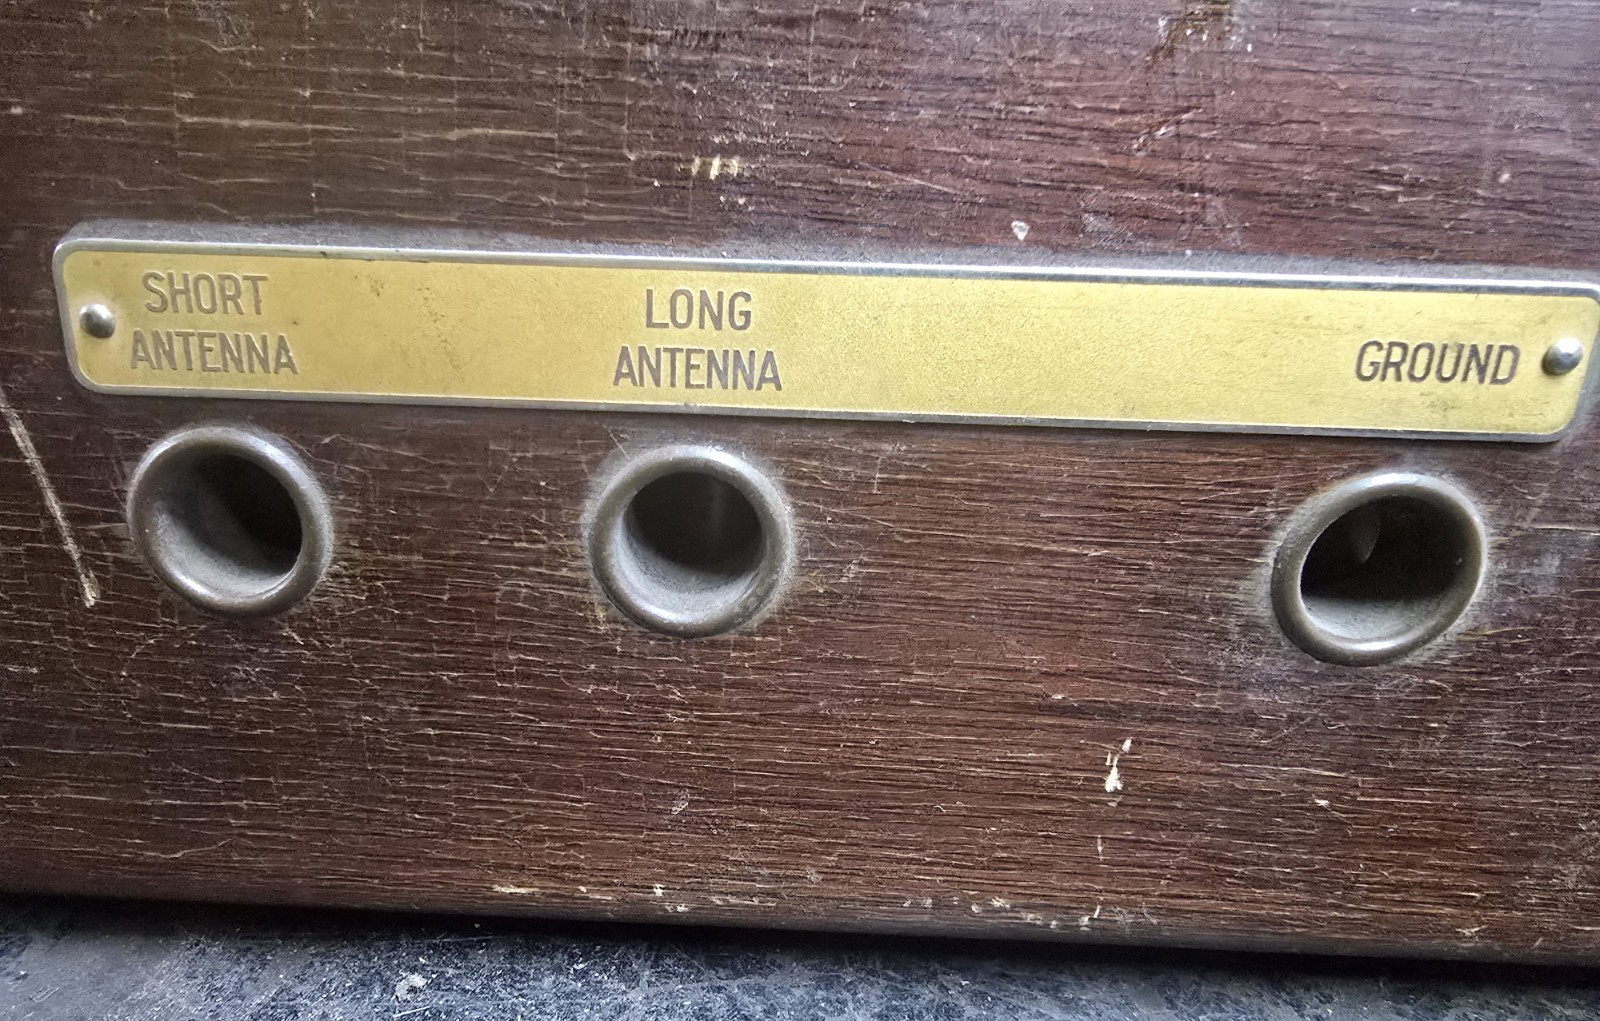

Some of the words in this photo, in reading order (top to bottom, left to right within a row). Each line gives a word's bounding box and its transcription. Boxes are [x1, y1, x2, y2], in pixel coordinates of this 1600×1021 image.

[142, 271, 269, 316] SHORT
[645, 287, 753, 331] LONG
[131, 329, 298, 376] ANTENNA
[613, 346, 783, 392] ANTENNA
[1356, 341, 1520, 385] GROUND
